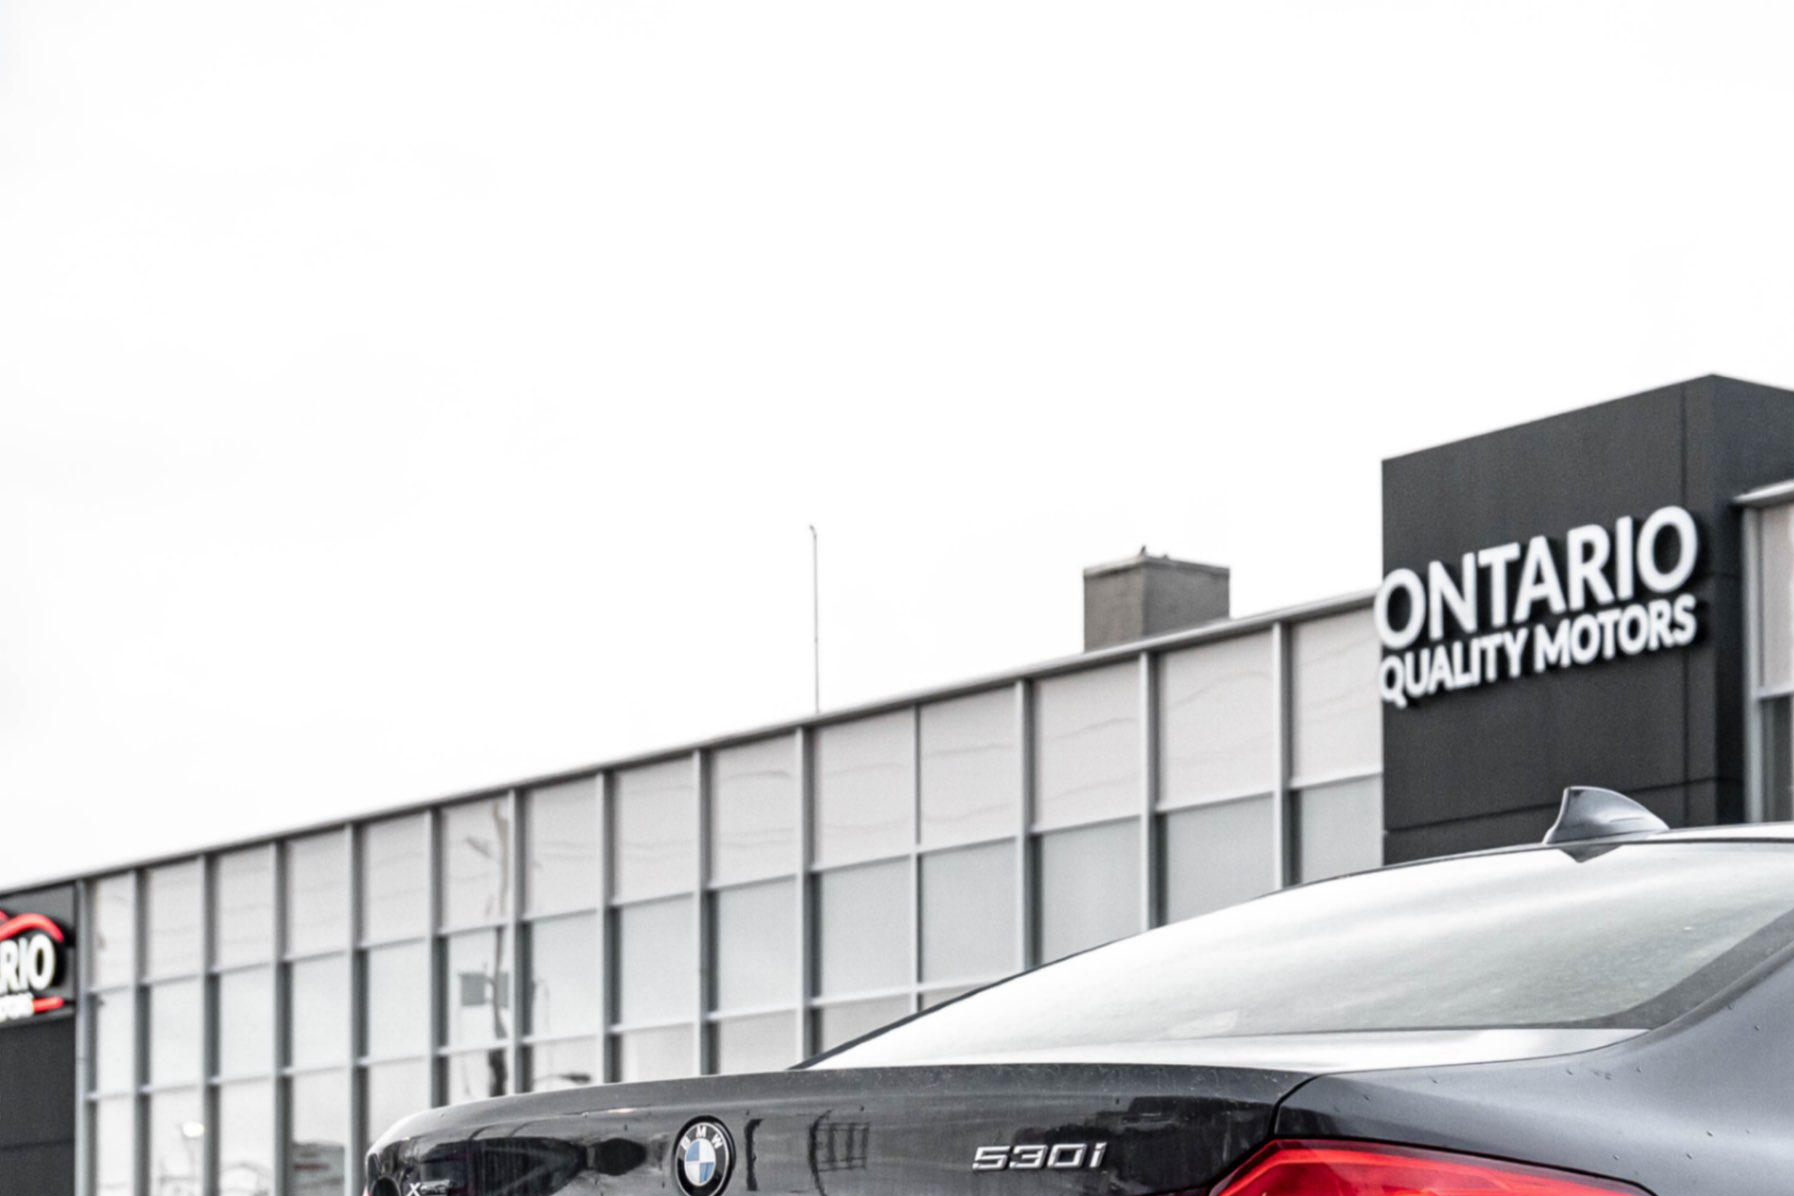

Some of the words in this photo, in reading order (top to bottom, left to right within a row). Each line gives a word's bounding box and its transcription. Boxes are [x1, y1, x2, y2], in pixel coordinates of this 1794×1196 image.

[1374, 505, 1698, 650] ONTARIO
[1378, 626, 1529, 709] QUALITY
[1534, 593, 1697, 673] MOTORS
[680, 1125, 723, 1150] BMW
[972, 1142, 1107, 1170] 530i
